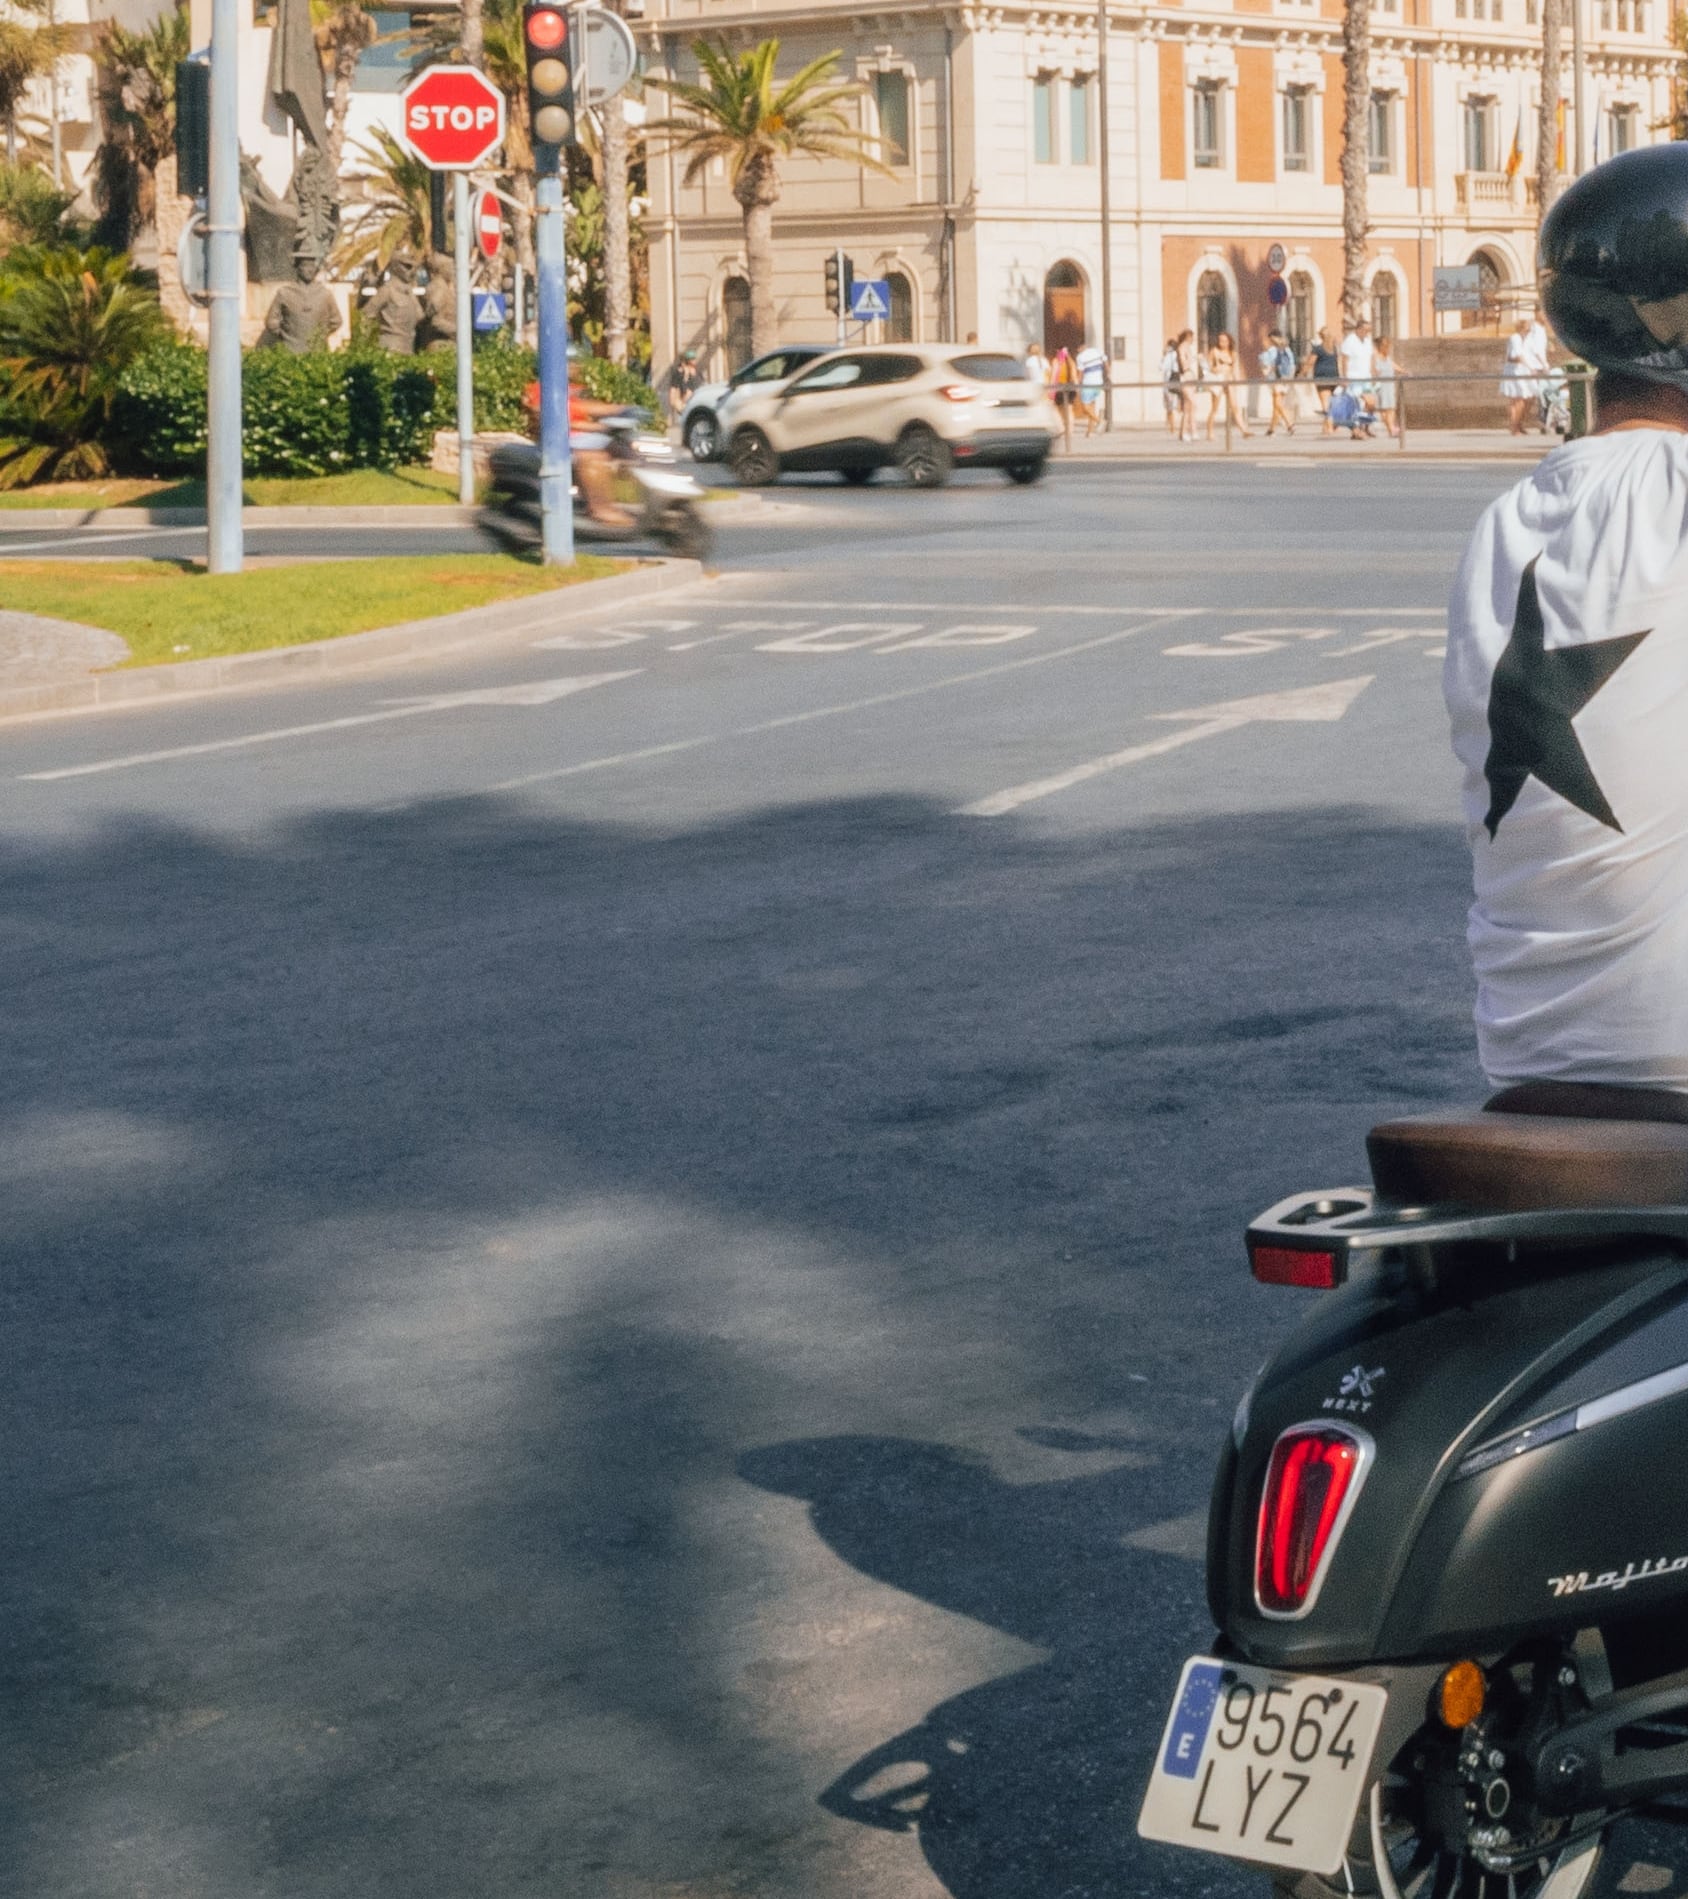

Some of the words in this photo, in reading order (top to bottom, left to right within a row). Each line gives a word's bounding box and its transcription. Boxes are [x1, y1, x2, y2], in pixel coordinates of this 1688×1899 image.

[409, 104, 496, 131] STOP
[530, 619, 1039, 654] STOP
[1161, 627, 1448, 657] ST
[1217, 1682, 1360, 1771] 9564
[1176, 1732, 1195, 1760] E
[1191, 1759, 1311, 1847] LYZ
